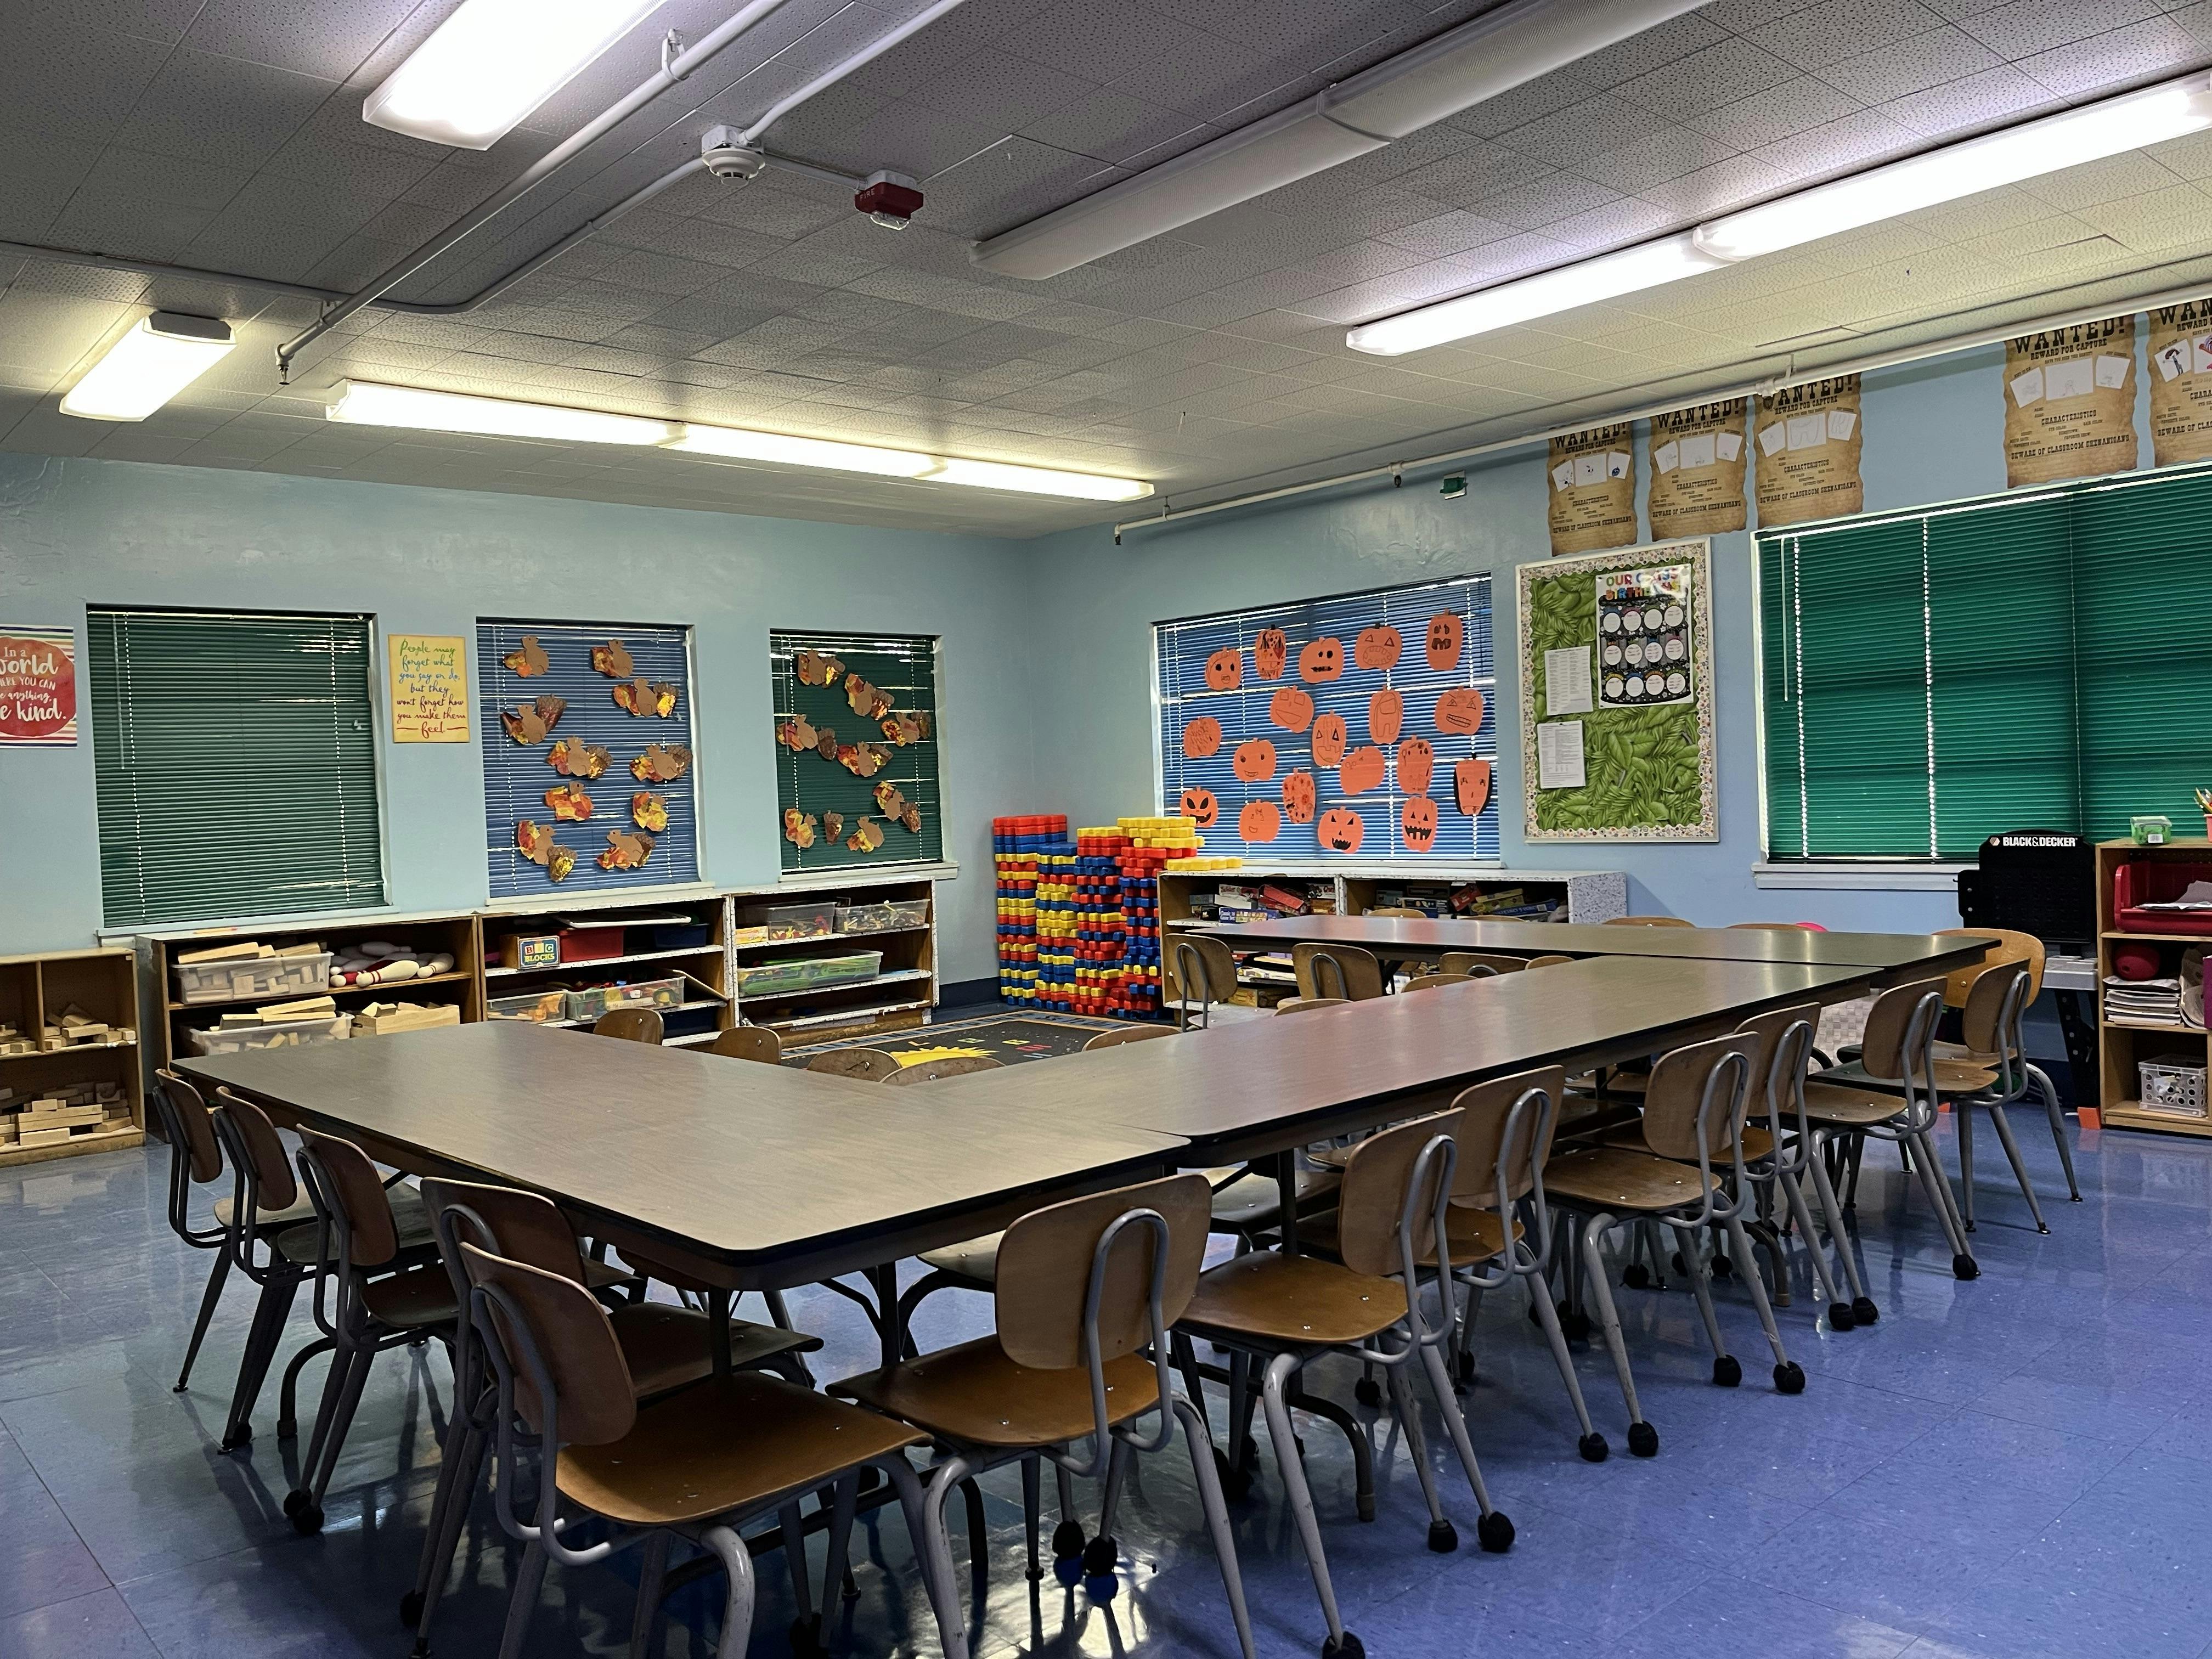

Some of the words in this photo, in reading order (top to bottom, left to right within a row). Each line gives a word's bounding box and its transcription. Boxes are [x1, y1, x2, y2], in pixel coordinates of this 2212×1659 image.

[860, 188, 875, 201] FIRE
[2177, 319, 2207, 332] REWARD
[2015, 317, 2125, 354] WANTED!
[2030, 348, 2059, 360] REWARD
[2062, 345, 2074, 354] FOR
[2076, 338, 2107, 351] CAPTURE
[1778, 375, 1853, 406] ANTED!
[1657, 399, 1740, 428] WANTED!
[1775, 404, 1798, 415] REWARD
[1799, 400, 1810, 409] FOR
[1812, 395, 1838, 407] CAPTURE
[2041, 410, 2096, 425] CHARACTERISTICS
[1669, 425, 1690, 434] REWARD
[1703, 419, 1726, 428] CAPTURE
[2158, 426, 2185, 436] BEWARE
[1555, 423, 1627, 449] WANTED!
[2011, 449, 2036, 460] BEWARE
[2047, 442, 2084, 454] CLASSROOM
[2086, 435, 2130, 448] SHENANIGANS
[1784, 459, 1830, 473] CHARACTERISTICS
[1677, 478, 1718, 490] CHARACTERISTICS
[1760, 494, 1780, 504] BEWARE
[1790, 488, 1819, 498] CLASSROOM
[1821, 481, 1857, 493] SHENANIGANS
[1652, 509, 1672, 517] BEWARE
[1680, 505, 1707, 514] CLASSROOM
[1708, 500, 1741, 511] SHENANIGANS
[1606, 573, 1632, 586] OUR
[4, 647, 17, 657] In
[399, 639, 431, 656] People
[433, 647, 456, 659] may
[402, 654, 430, 672] forget
[433, 654, 455, 666] what
[19, 676, 36, 687] YOU
[39, 679, 56, 691] CAN
[399, 673, 415, 684] you
[418, 673, 432, 684] say
[410, 682, 425, 693] but
[429, 680, 450, 697] they
[16, 698, 66, 723] kind.
[420, 696, 447, 713] forget
[448, 693, 464, 706] how
[397, 713, 412, 724] you
[414, 708, 441, 719] make
[443, 707, 466, 719] them
[524, 953, 555, 963] BLOCKS
[525, 944, 554, 955] BIG
